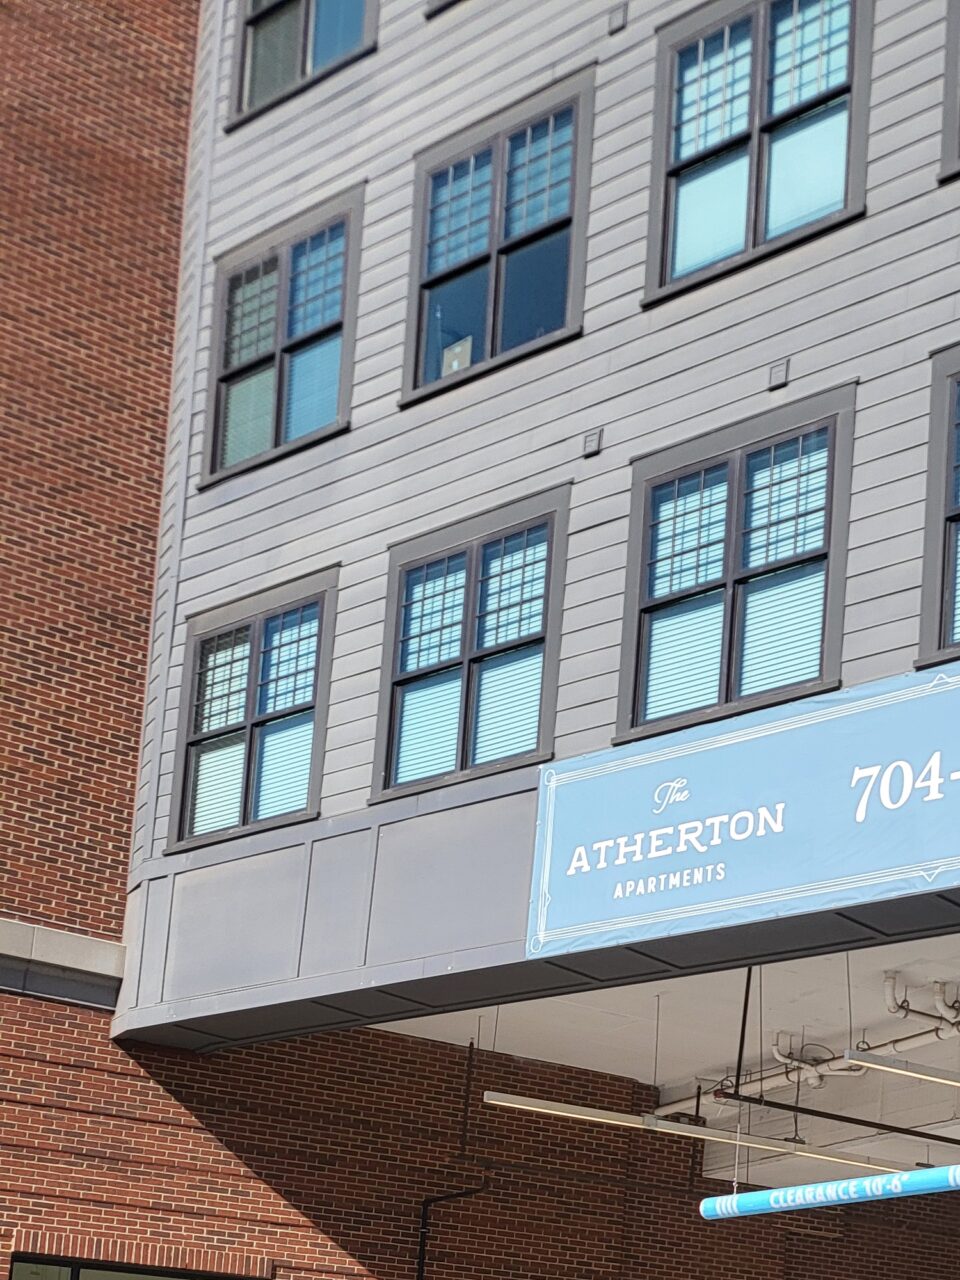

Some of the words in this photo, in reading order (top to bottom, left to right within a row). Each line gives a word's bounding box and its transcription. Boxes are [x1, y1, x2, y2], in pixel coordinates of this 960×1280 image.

[652, 777, 690, 814] The
[566, 802, 785, 876] ATHERTON
[613, 862, 726, 899] APARTMENTS
[769, 1181, 859, 1208] CLEARANCE
